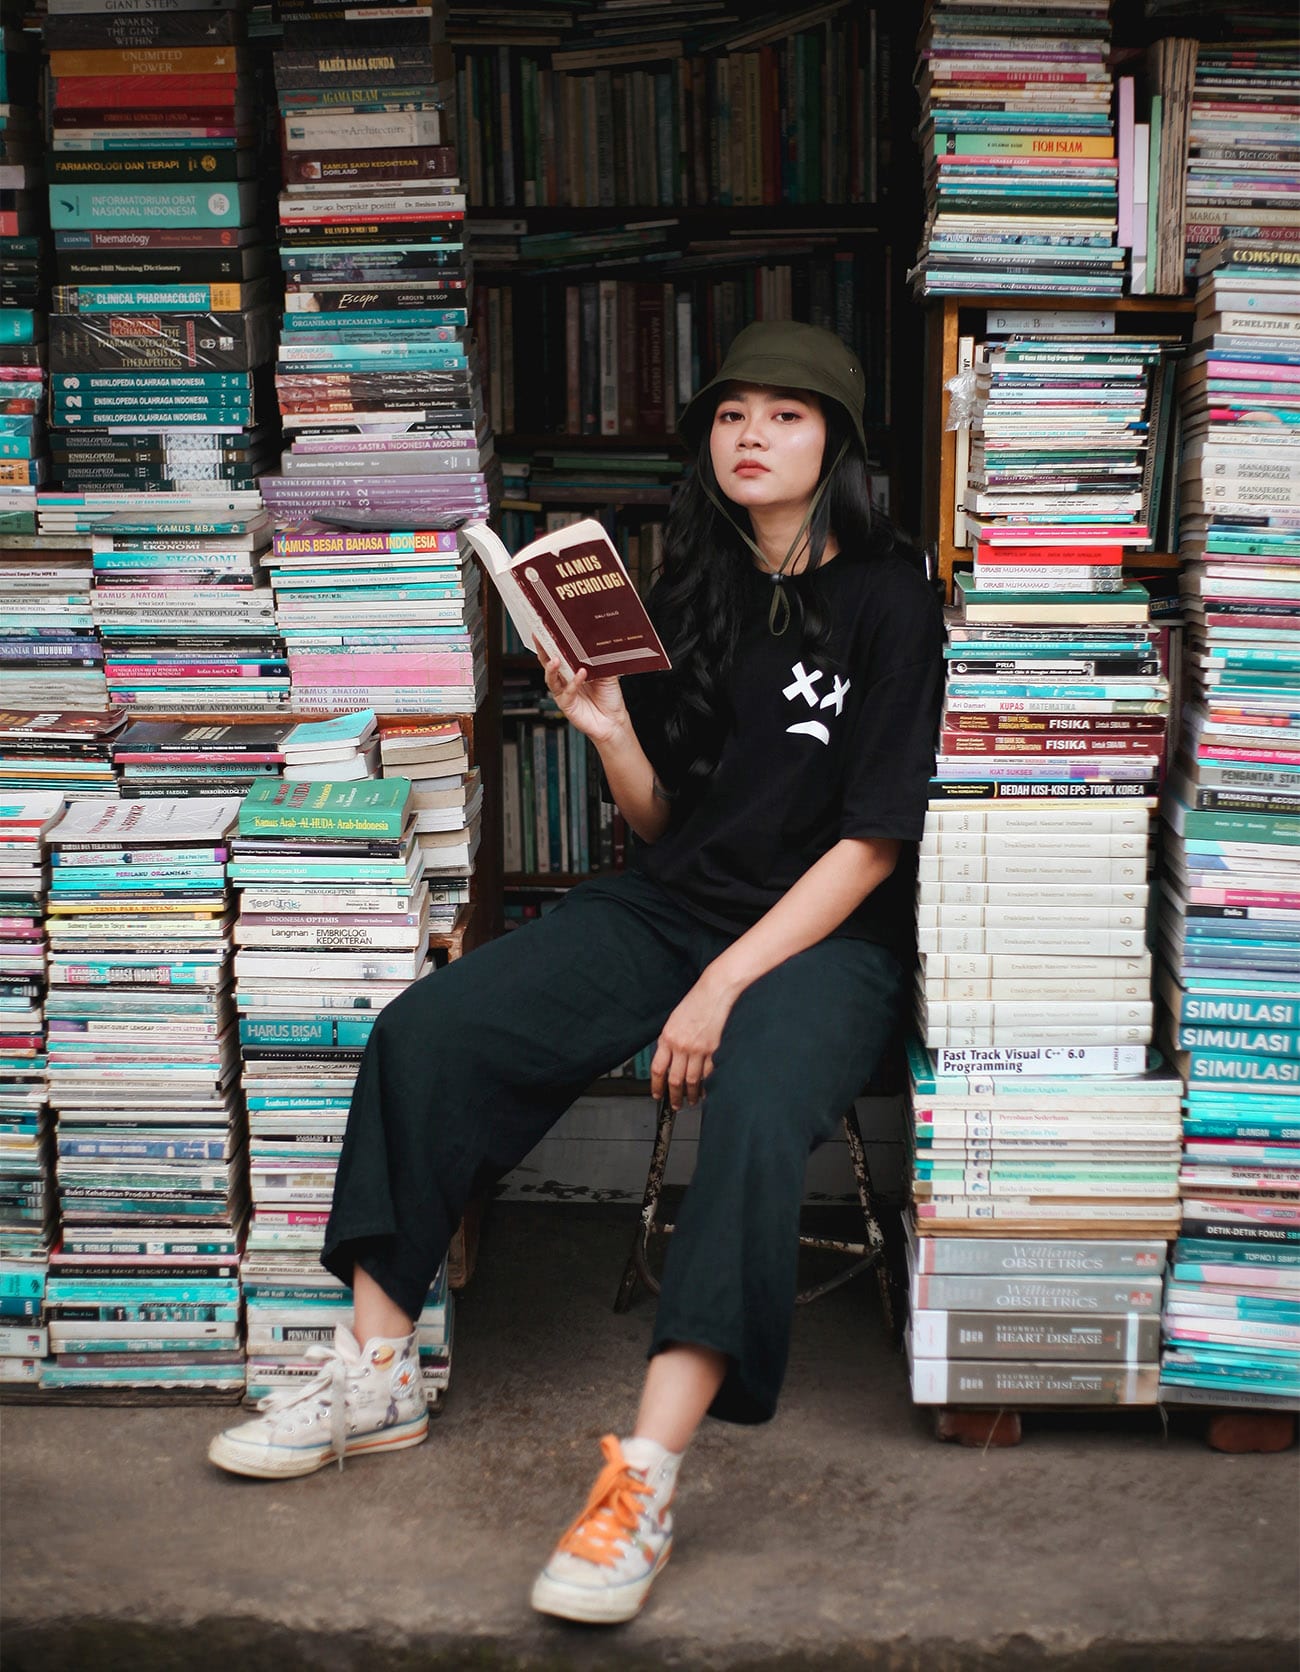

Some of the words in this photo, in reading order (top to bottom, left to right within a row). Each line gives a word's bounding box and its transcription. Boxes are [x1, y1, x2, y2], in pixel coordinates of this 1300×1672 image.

[114, 17, 153, 26] AWAKEN
[122, 51, 182, 61] UNLIMITED
[132, 64, 173, 73] POWER
[348, 57, 368, 70] BASA
[368, 57, 395, 69] SUNDA
[1056, 140, 1083, 153] ISLAM
[56, 162, 122, 171] FARMAKOLOGI
[125, 161, 144, 170] DAN
[146, 160, 179, 170] TERAPI
[91, 196, 170, 206] INFORMATORIUM
[172, 195, 196, 205] OBAT
[92, 206, 142, 216] NASIONAL
[144, 206, 197, 216] INDONESIA
[1188, 225, 1221, 235] SCOTT
[95, 233, 150, 246] Haematology
[71, 264, 114, 272] McGraw-Hill
[115, 264, 143, 273] Nursing
[144, 264, 181, 272] Dictionary
[96, 293, 134, 304] CLINICAL
[137, 292, 207, 304] PHARMACOLOGY
[338, 293, 379, 309] Escape
[292, 318, 336, 327] ORGANISASI
[337, 318, 383, 326] KECAMATAN
[1232, 319, 1290, 329] PENELITIAN
[63, 377, 80, 389] 3
[90, 378, 134, 387] ENSIKLOPEDIA
[135, 378, 169, 387] OLAHRAGA
[171, 378, 205, 386] INDONESIA
[66, 395, 82, 408] 2
[94, 397, 139, 405] ENSIKLOPEDIA
[140, 396, 173, 405] OLAHRAGA
[174, 396, 209, 405] INDONESIA
[65, 414, 81, 423] 1
[93, 414, 137, 422] ENSIKLOPEDIA
[138, 414, 171, 422] OLAHRAGA
[173, 413, 207, 421] INDONESIA
[304, 444, 357, 452] ENSIKLOPEDIA
[358, 443, 387, 451] SASTRA
[387, 442, 431, 450] INDONESIA
[432, 439, 467, 448] MODERN
[1237, 464, 1291, 472] MANAJEMEN
[357, 489, 368, 497] 2
[1237, 486, 1291, 494] MANAJEMEN
[157, 525, 191, 533] KAMUS
[194, 525, 215, 533] MBA
[277, 541, 311, 553] KAMUS
[313, 540, 344, 552] BESAR
[346, 537, 384, 550] BAHASA
[385, 535, 436, 549] INDONESIA
[555, 554, 602, 579] KAMUS
[555, 572, 626, 600] PSYCHOLOGI
[192, 609, 249, 617] ANTROPOLOGI
[209, 703, 275, 711] ANTROPOLOGI
[999, 702, 1024, 711] KUPAS
[1029, 703, 1076, 711] MATEMATIKA
[1049, 719, 1090, 729] FISIKA
[1045, 740, 1087, 750] FISIKA
[1221, 770, 1274, 782] PENGANTAR
[1000, 784, 1029, 796] BEDAH
[1031, 784, 1069, 796] KISI-KISI
[1070, 784, 1114, 795] EPS-TOPIK
[1115, 783, 1145, 795] KOREA
[1218, 793, 1270, 802] MANAGERIAL
[255, 817, 278, 827] Kamus
[280, 818, 296, 828] Arab
[337, 819, 389, 831] Arab-Indonesia
[271, 929, 309, 938] Langman
[316, 929, 367, 937] EMBRIOLOGI
[316, 937, 372, 945] KEDOKTERAN
[1120, 937, 1133, 947] 6
[135, 968, 170, 981] INDONESIA
[1185, 1000, 1292, 1023] SIMULASI
[247, 1025, 289, 1038] HARUS
[291, 1025, 322, 1038] BISA!
[1182, 1028, 1290, 1052] SIMULASI
[943, 1050, 966, 1060] Fast
[970, 1049, 1001, 1060] Track
[1005, 1049, 1041, 1060] Visual
[1068, 1049, 1085, 1059] 6.0
[943, 1061, 1023, 1073] Programming
[1194, 1059, 1299, 1081] SIMULASI
[1237, 1127, 1269, 1137] ULANGAN
[65, 1189, 84, 1197] Bukti
[85, 1189, 124, 1197] Kehebatan
[1207, 1225, 1258, 1238] DETIK-DETIK
[1258, 1229, 1286, 1238] FOKUS
[1012, 1246, 1087, 1258] Williams
[1006, 1283, 1081, 1296] Williams
[996, 1296, 1098, 1308] OBSTETRICS
[996, 1333, 1044, 1343] HEART
[1047, 1334, 1102, 1345] DISEASE
[996, 1381, 1044, 1390] HEART
[1047, 1381, 1102, 1391] DISEASE
